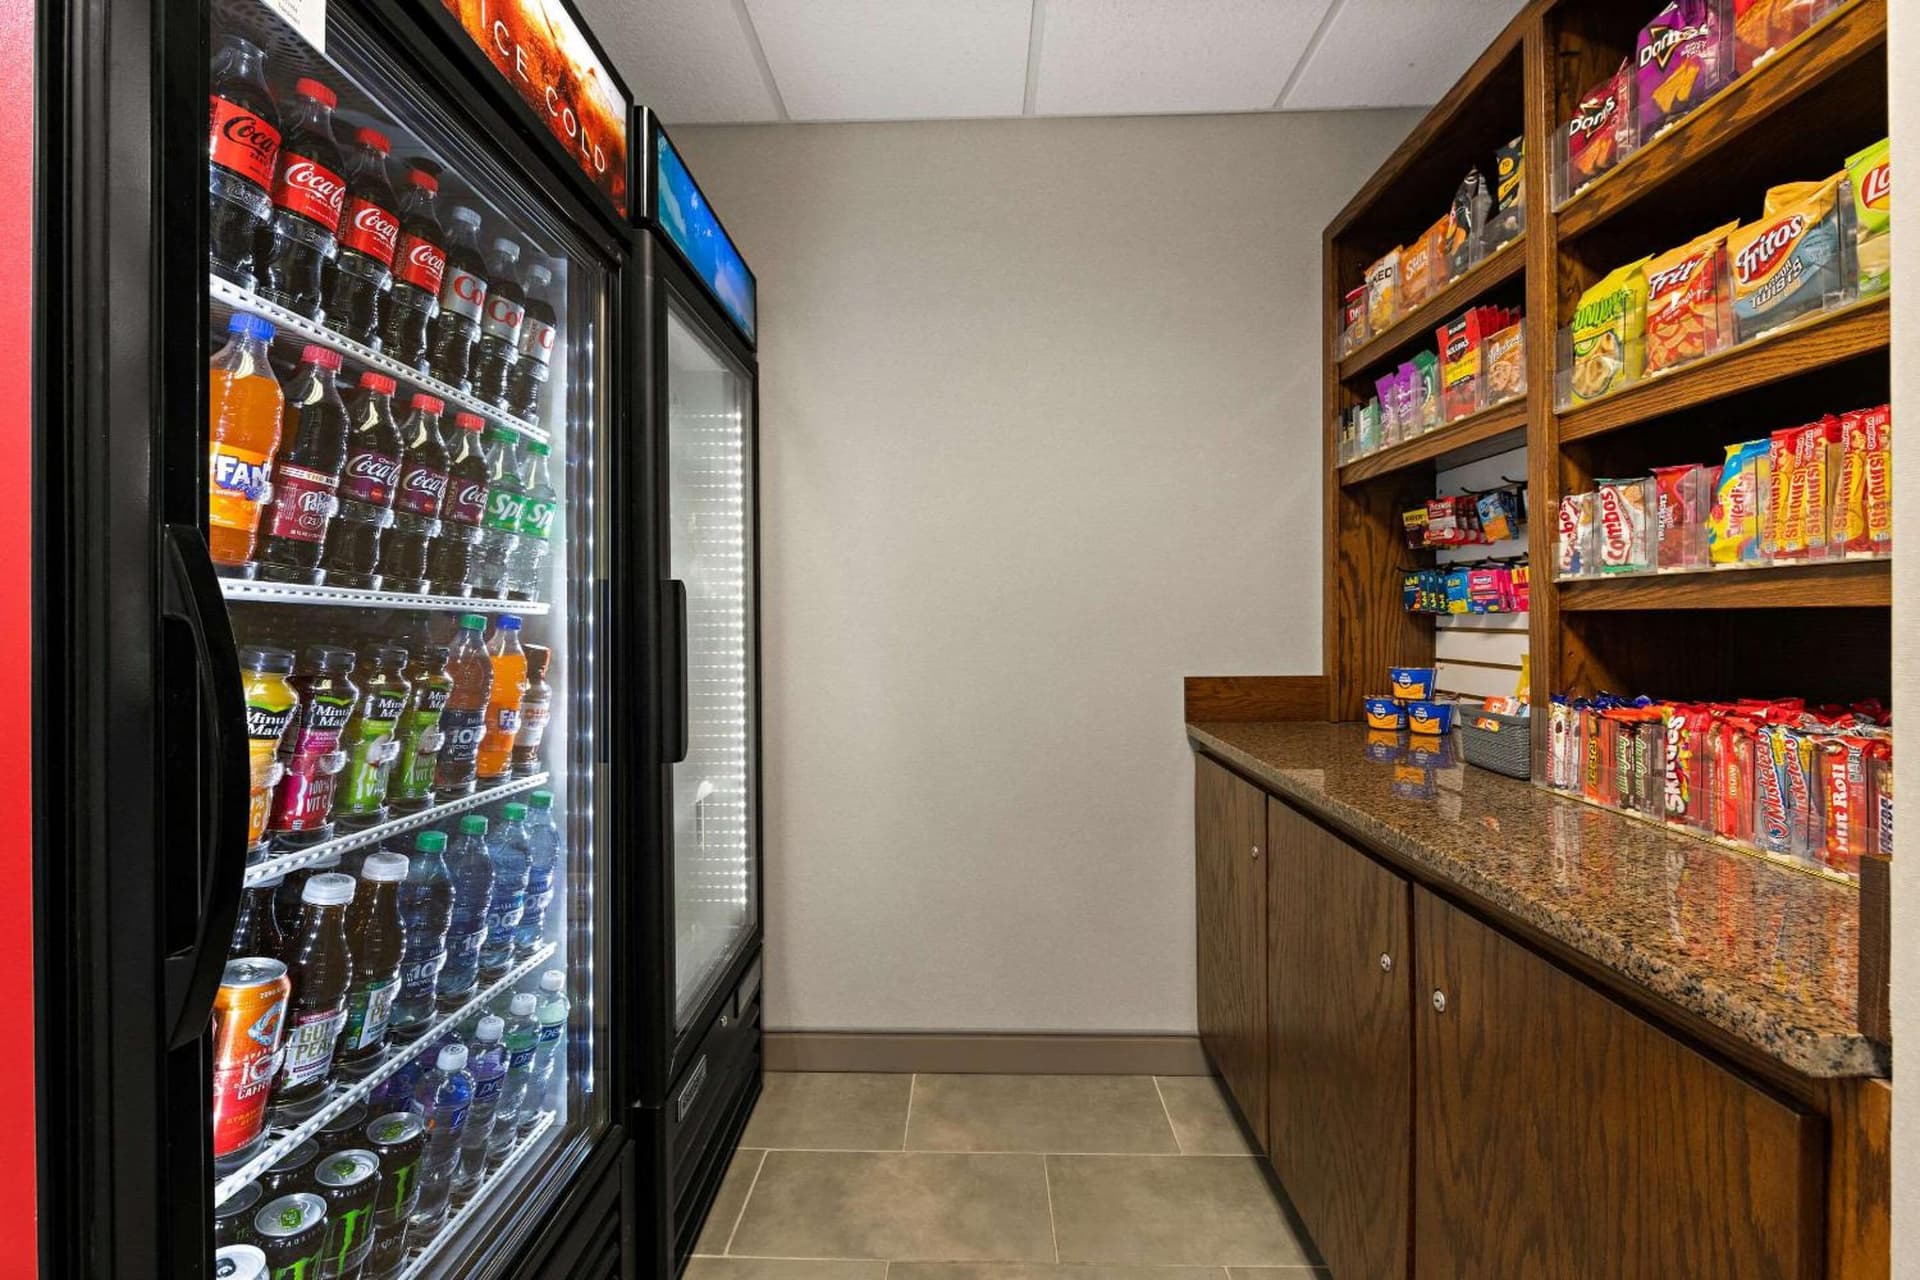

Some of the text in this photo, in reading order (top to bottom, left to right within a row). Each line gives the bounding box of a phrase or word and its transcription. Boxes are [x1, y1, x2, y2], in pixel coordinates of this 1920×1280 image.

[481, 0, 605, 172] ICE COLD
[1736, 215, 1803, 284] Fritos
[1602, 490, 1626, 561] Combos
[1664, 716, 1687, 814] Skittles
[1832, 763, 1848, 808] Roll
